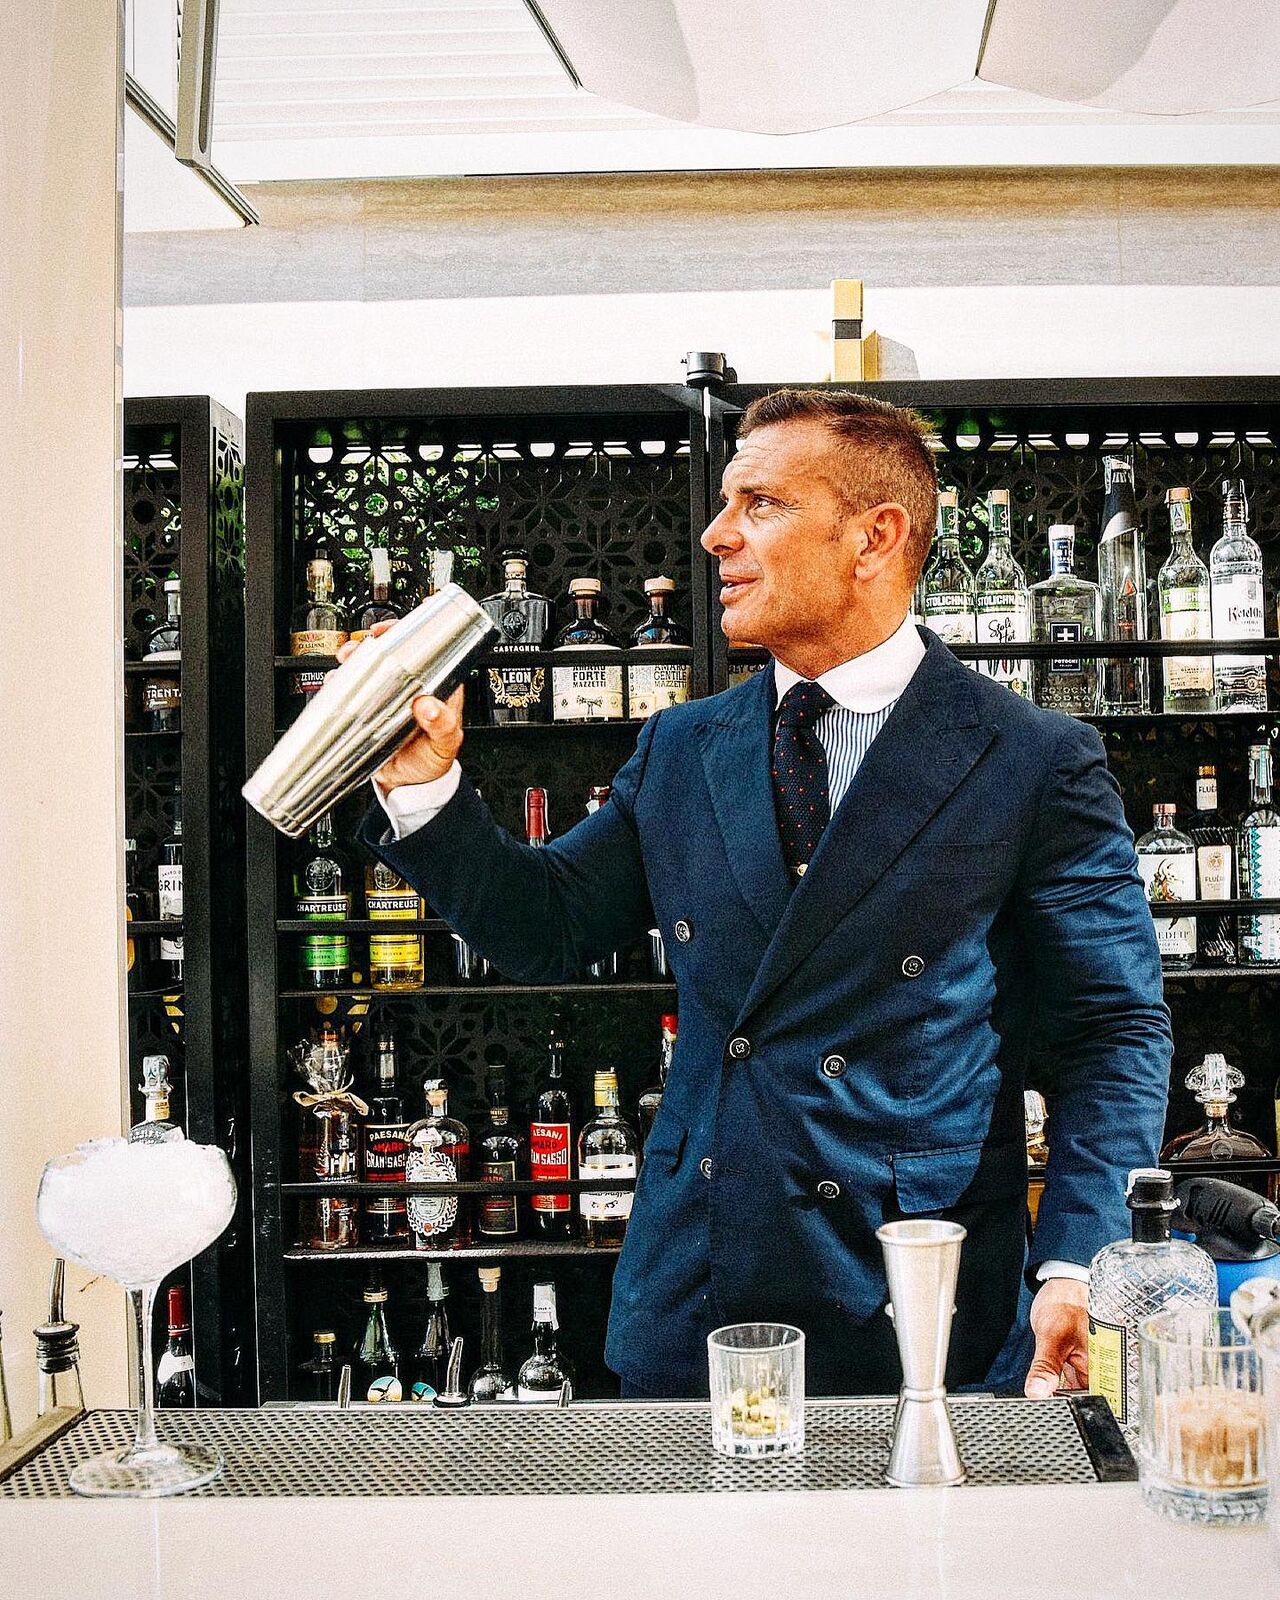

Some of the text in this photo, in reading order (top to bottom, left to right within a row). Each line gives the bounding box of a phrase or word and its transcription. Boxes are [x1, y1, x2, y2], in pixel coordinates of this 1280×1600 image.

[301, 672, 325, 682] ZETHUS
[502, 671, 532, 684] LEON
[573, 671, 606, 681] FORTE
[654, 670, 687, 681] GENTILE
[573, 680, 607, 688] MAZZETTI
[146, 689, 182, 699] TRENT
[297, 903, 347, 913] CHARTREUSE
[368, 900, 419, 910] CHARTREUSE
[369, 1130, 405, 1142] PAESAN
[541, 1148, 567, 1165] SASSO
